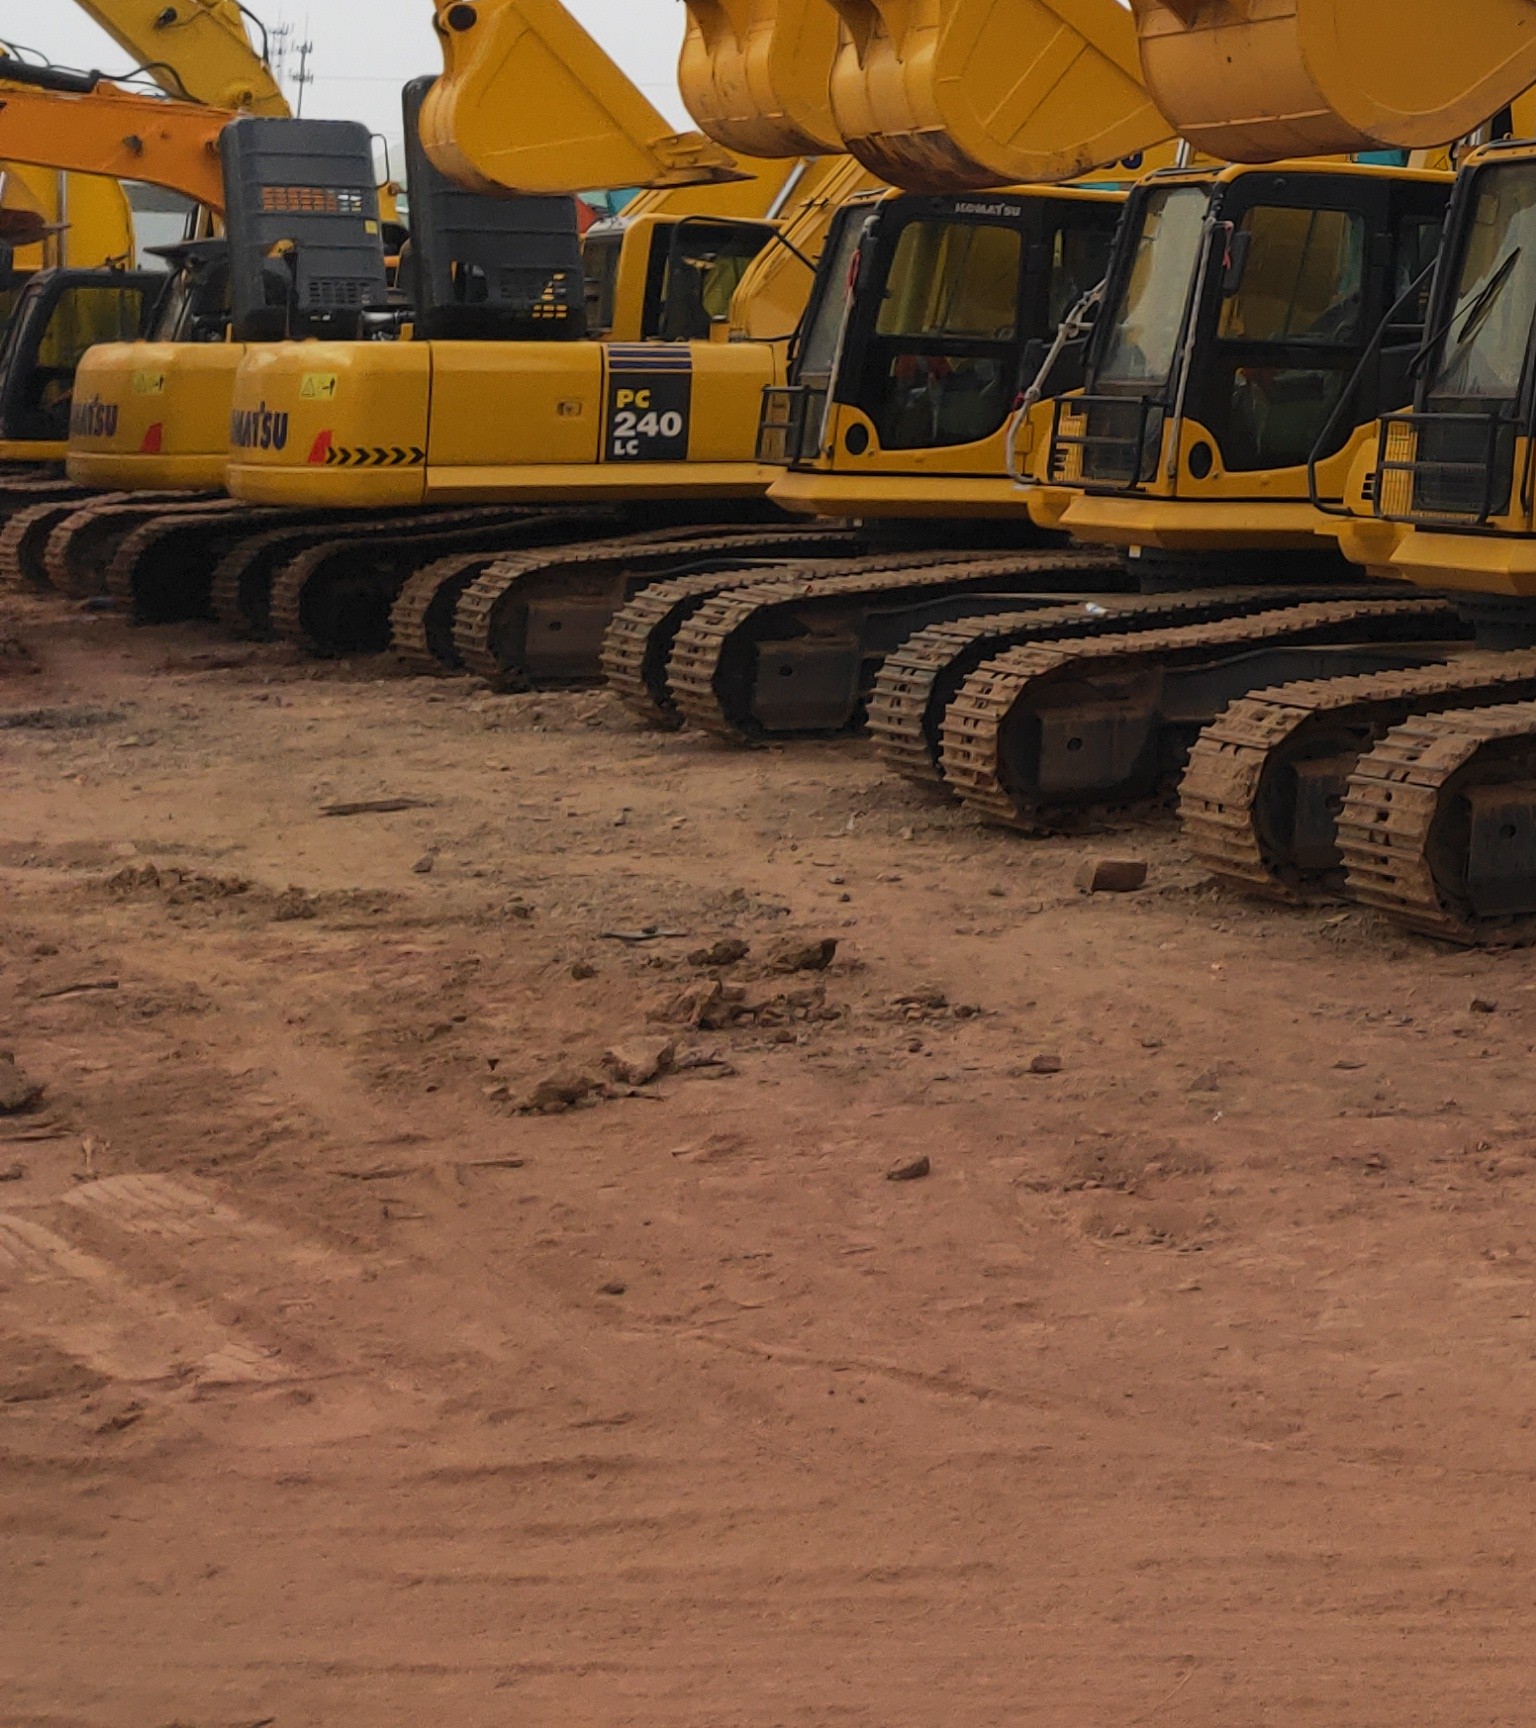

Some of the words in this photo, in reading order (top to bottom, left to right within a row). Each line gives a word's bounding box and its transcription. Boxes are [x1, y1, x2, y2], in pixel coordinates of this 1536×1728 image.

[954, 202, 1021, 217] KOMATSU
[616, 388, 651, 408] PC
[613, 410, 683, 437] 240
[613, 439, 640, 456] LC
